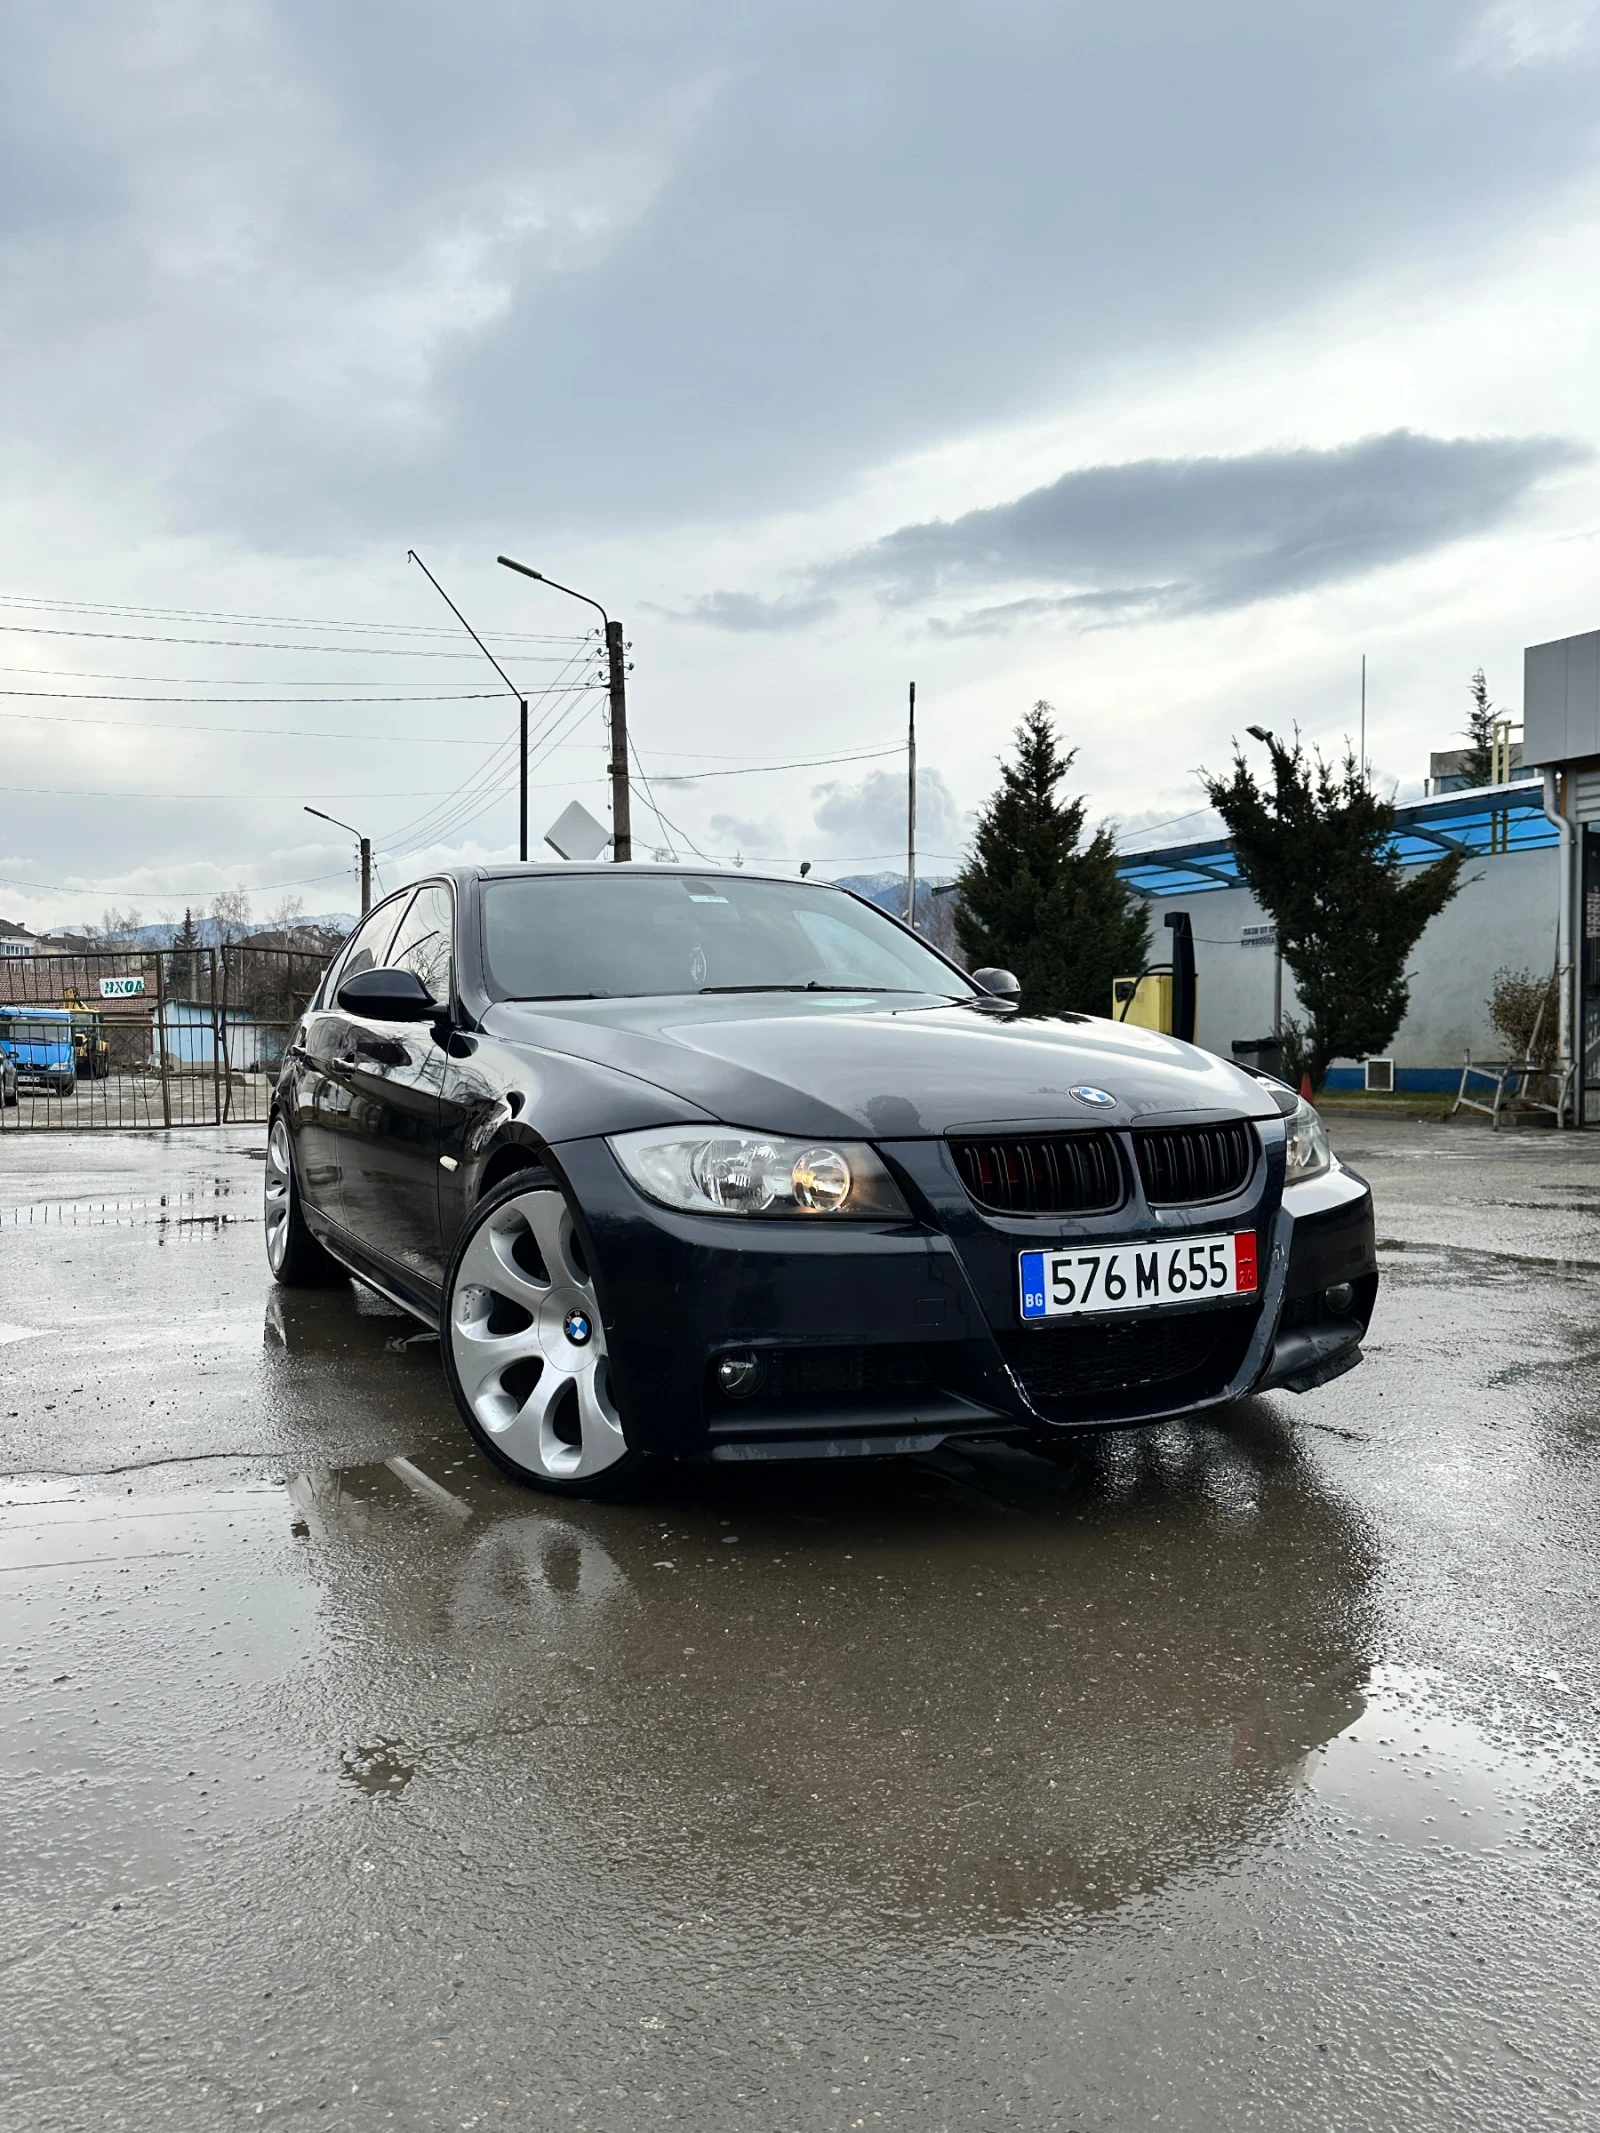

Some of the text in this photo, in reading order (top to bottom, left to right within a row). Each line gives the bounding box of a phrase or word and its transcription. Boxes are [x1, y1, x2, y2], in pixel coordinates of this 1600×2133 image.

[104, 980, 143, 995] ВХОД
[1025, 1293, 1043, 1308] BG
[1052, 1254, 1127, 1306] 576
[1135, 1251, 1160, 1298] M
[1167, 1243, 1228, 1294] 655
